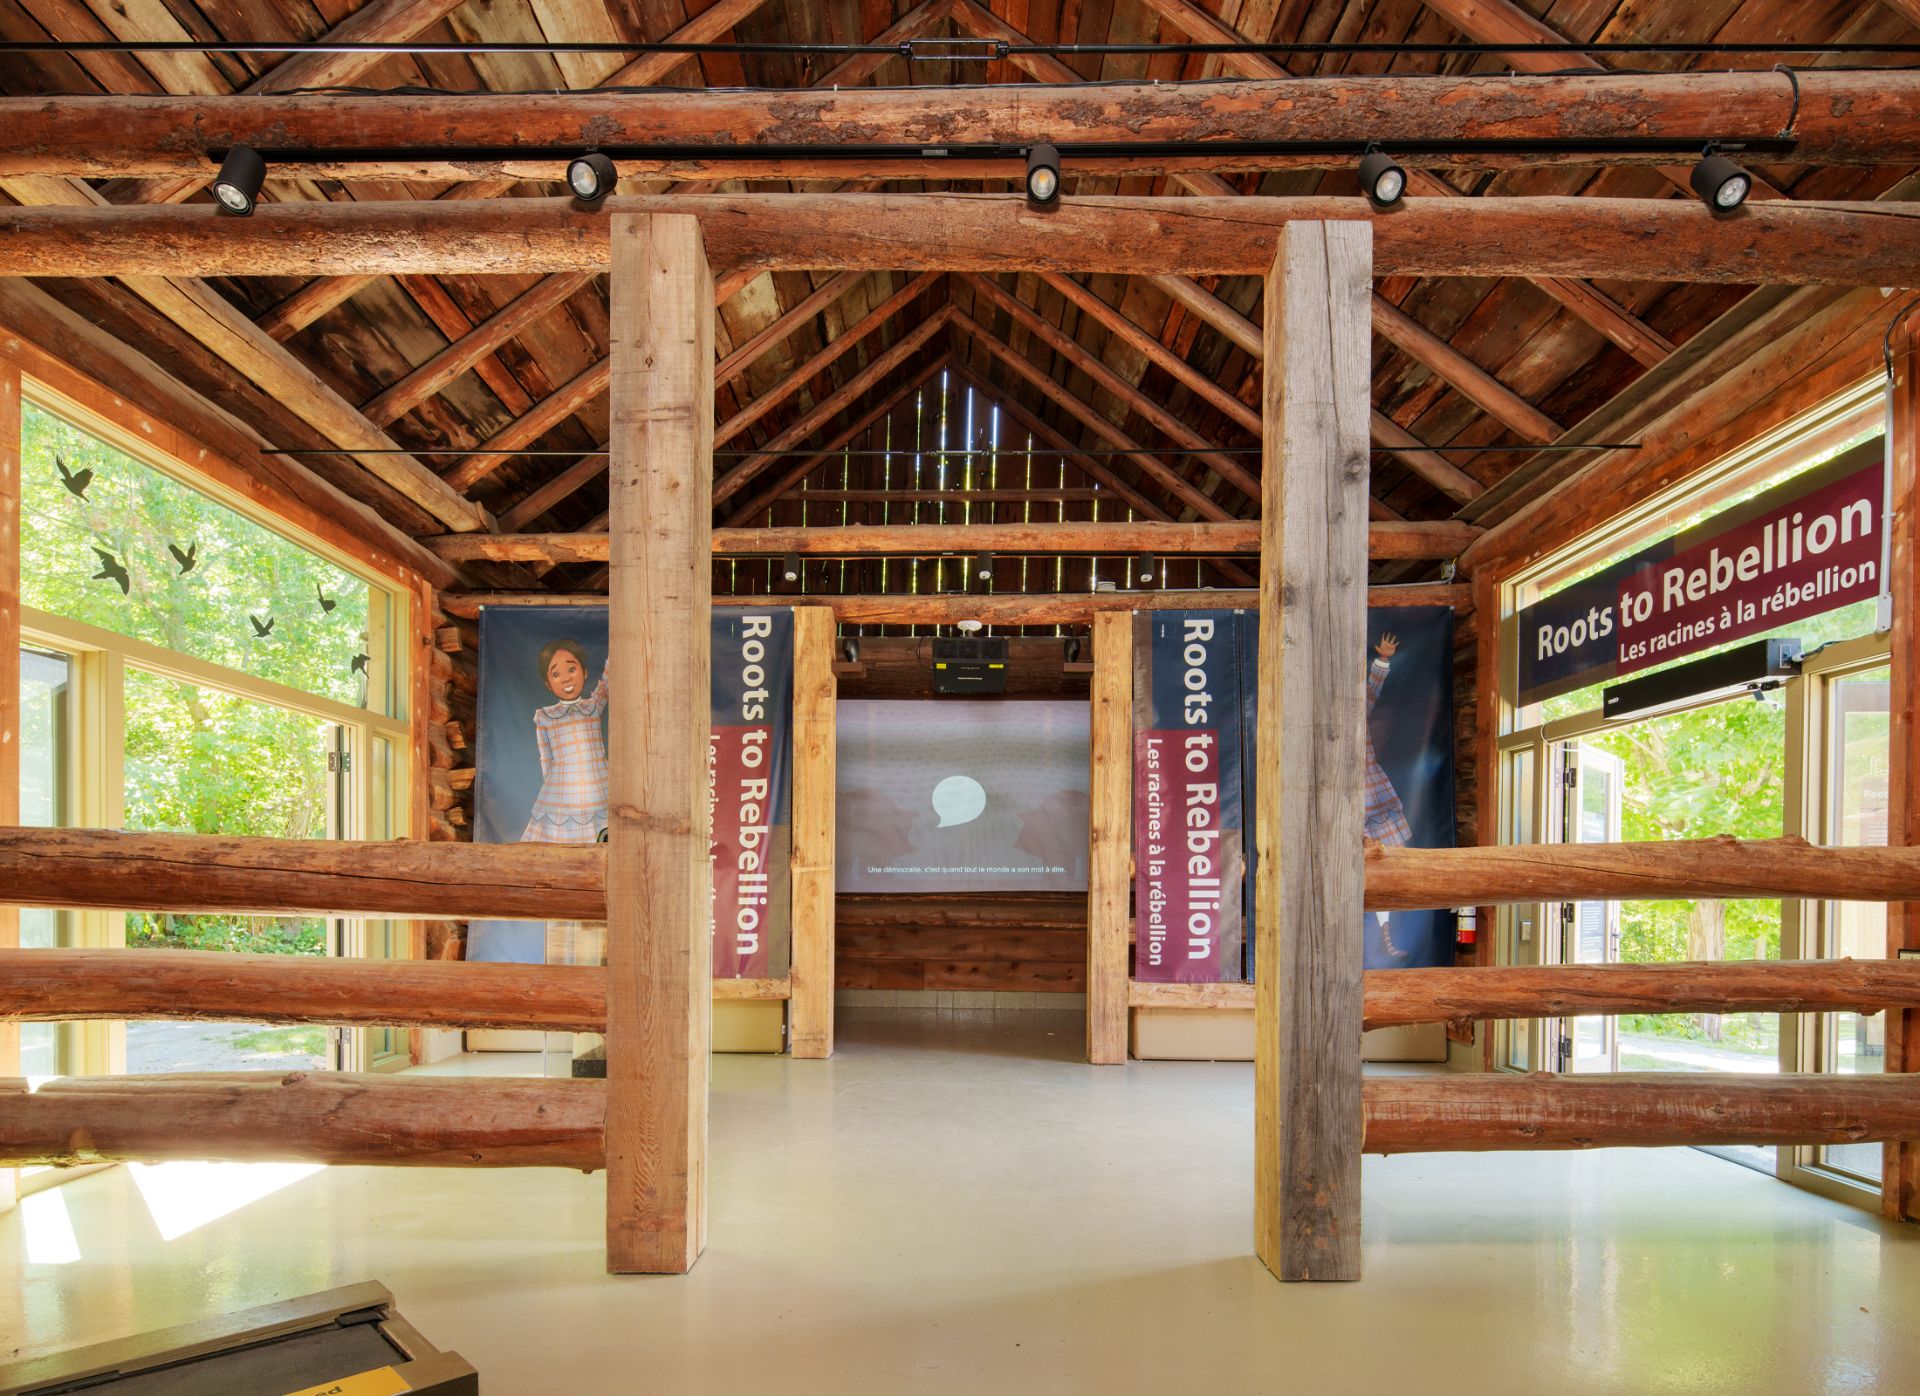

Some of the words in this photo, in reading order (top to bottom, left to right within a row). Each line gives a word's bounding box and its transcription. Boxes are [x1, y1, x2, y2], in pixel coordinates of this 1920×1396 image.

[1537, 606, 1613, 661] Roots
[1620, 591, 1654, 628] to
[1663, 498, 1872, 613] Rebellion
[1620, 640, 1646, 663] Les
[1650, 616, 1715, 653] racines
[1719, 606, 1732, 629] à
[1737, 600, 1755, 625] la
[1761, 560, 1876, 616] rébellion
[742, 615, 773, 721] Roots
[1183, 619, 1215, 725] Roots
[741, 729, 768, 768] to
[1147, 738, 1163, 769] Les
[1185, 733, 1213, 772] to
[1148, 773, 1164, 840] racines
[736, 778, 769, 955] Rebellion
[867, 865, 882, 873] Une
[924, 865, 941, 873] c'est
[941, 865, 963, 876] quand
[964, 865, 978, 873] tout
[978, 865, 985, 873] le
[986, 865, 1010, 873] monde
[1031, 865, 1044, 873] mot
[1051, 865, 1066, 873] dire.
[1148, 844, 1166, 855] à
[1149, 860, 1166, 876] la
[1186, 783, 1220, 959] Rebellion
[1149, 881, 1167, 966] rébellion
